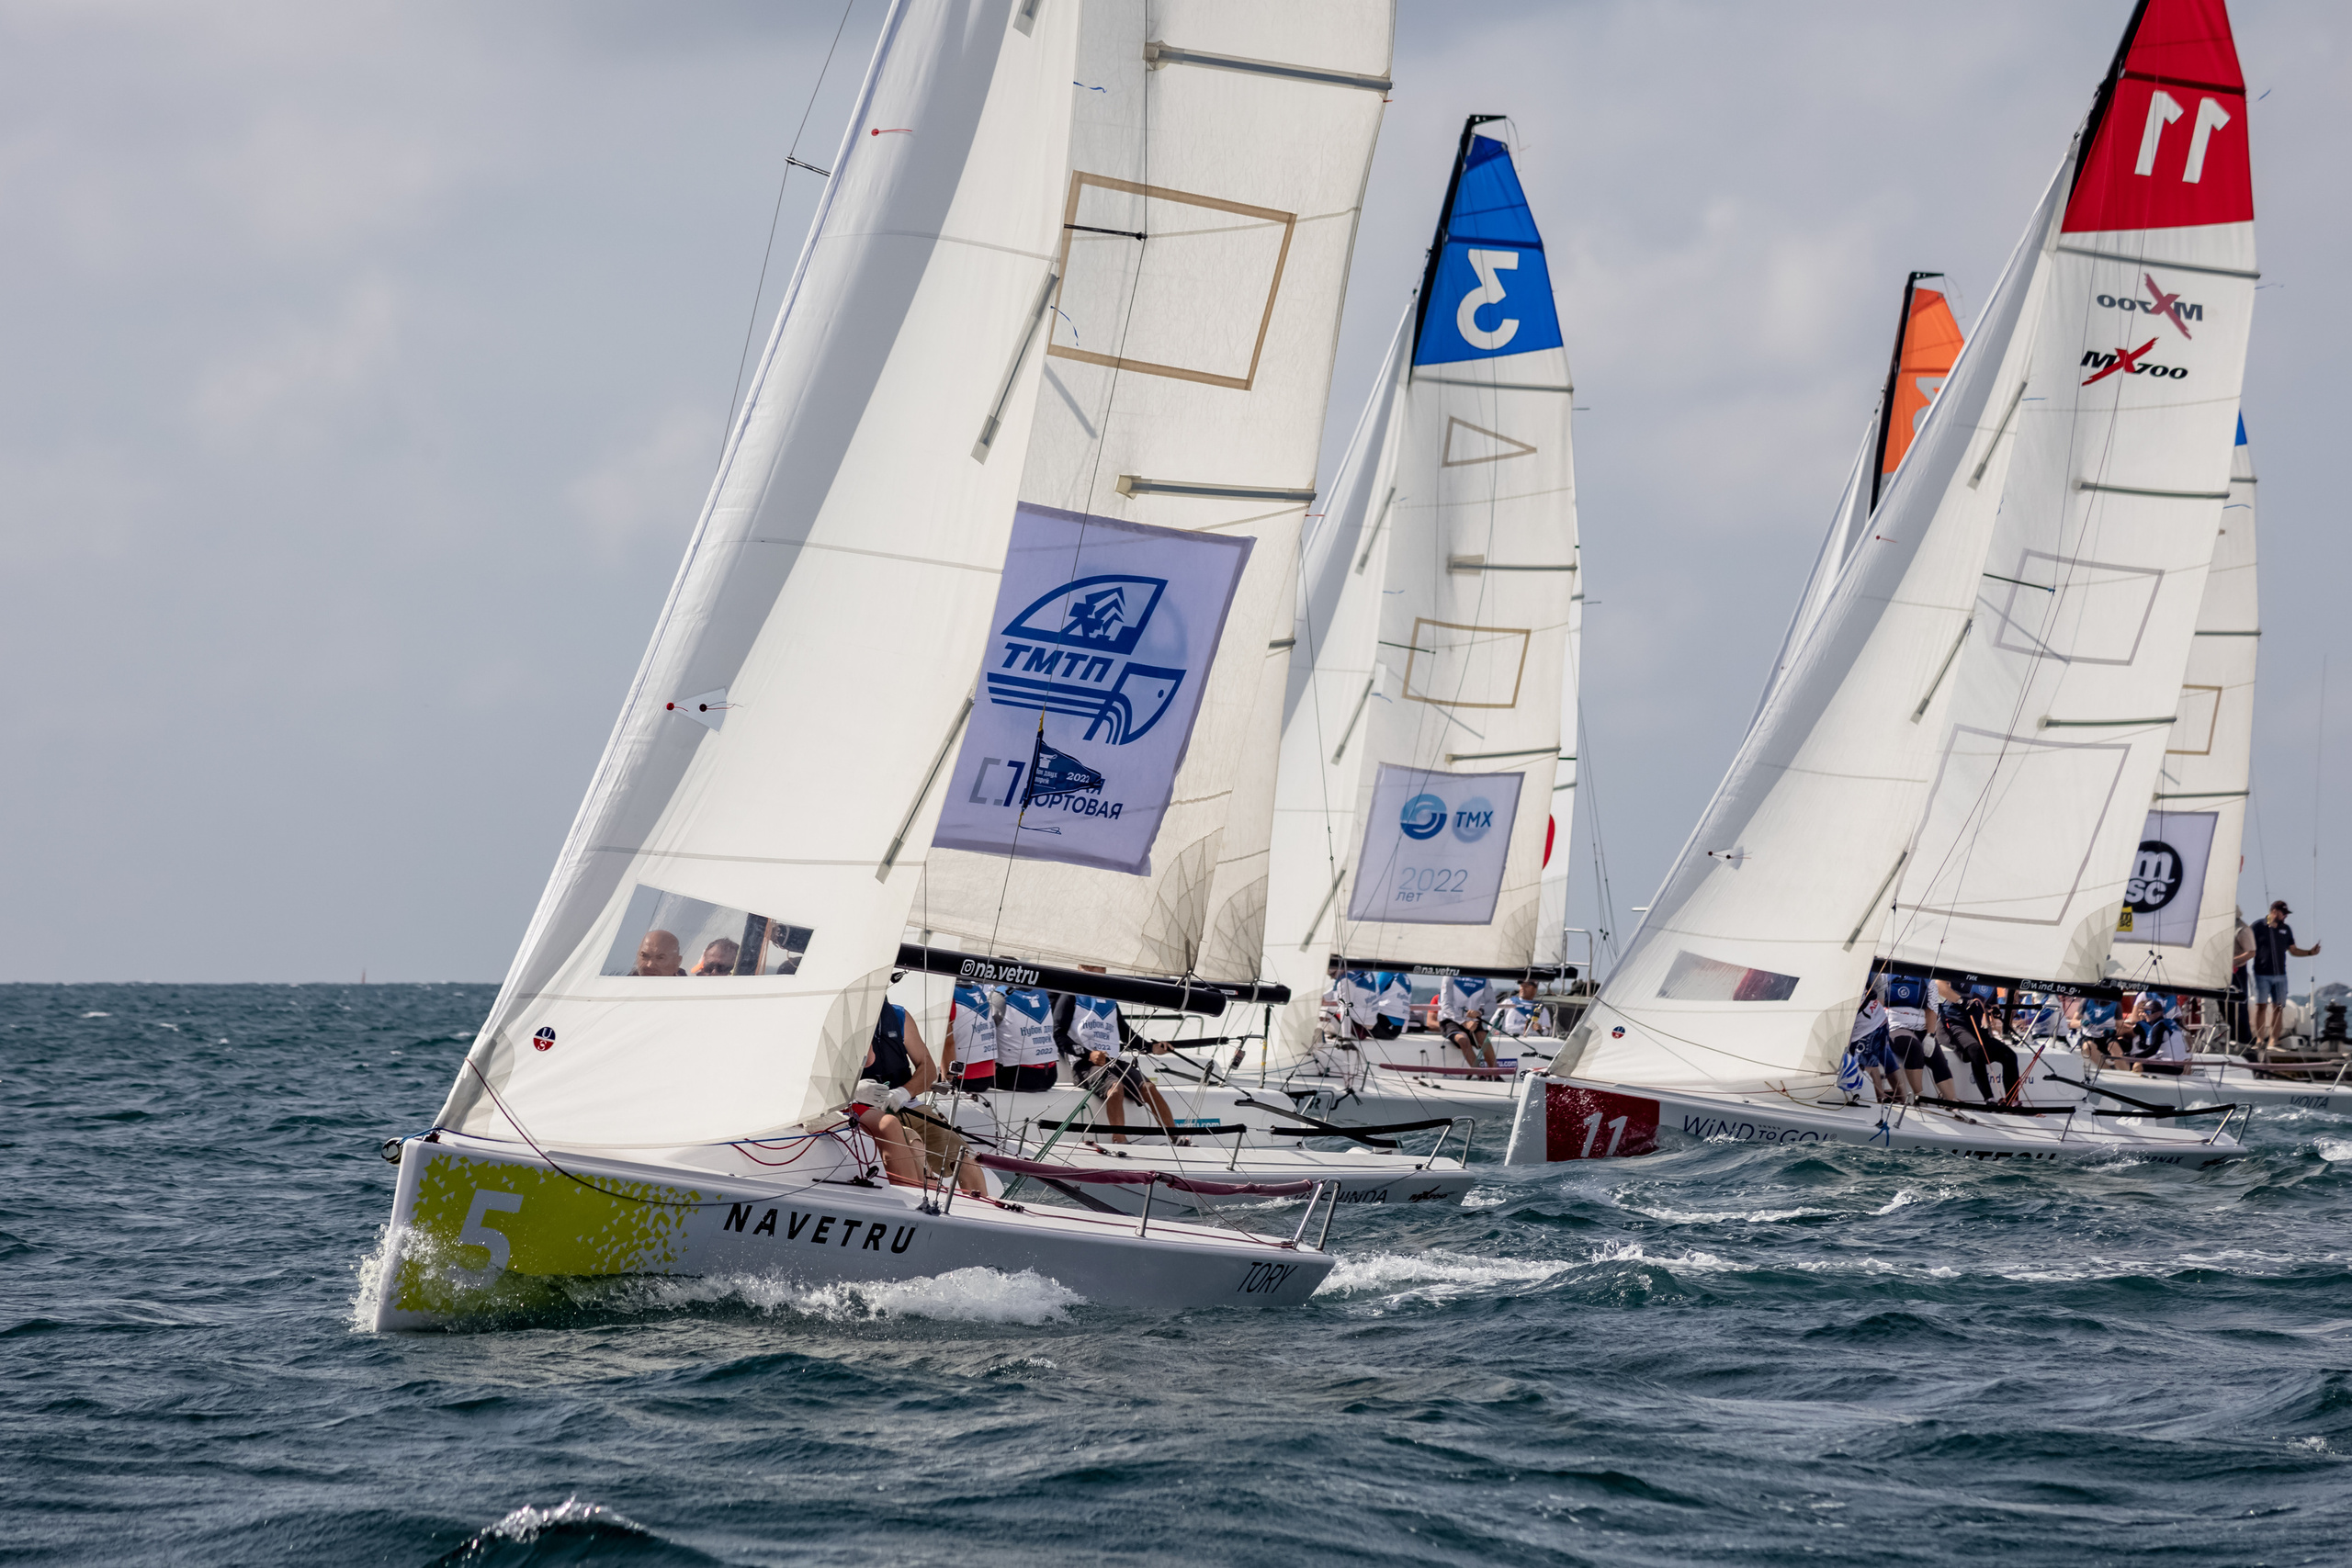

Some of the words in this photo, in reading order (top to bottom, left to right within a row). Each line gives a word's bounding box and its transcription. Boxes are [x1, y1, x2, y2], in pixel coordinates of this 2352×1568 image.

[2080, 336, 2188, 387] MX700
[1001, 642, 1114, 682] ТМТП
[1066, 773, 1091, 784] 2022
[1395, 891, 1424, 902] лет
[1398, 867, 1468, 893] 2022
[1035, 1047, 1054, 1055] 2022
[1094, 1043, 1112, 1051] 2022
[1580, 1111, 1628, 1157] 11
[446, 1188, 525, 1288] 5
[723, 1202, 916, 1254] NAVETRU
[1237, 1261, 1299, 1294] TORY
